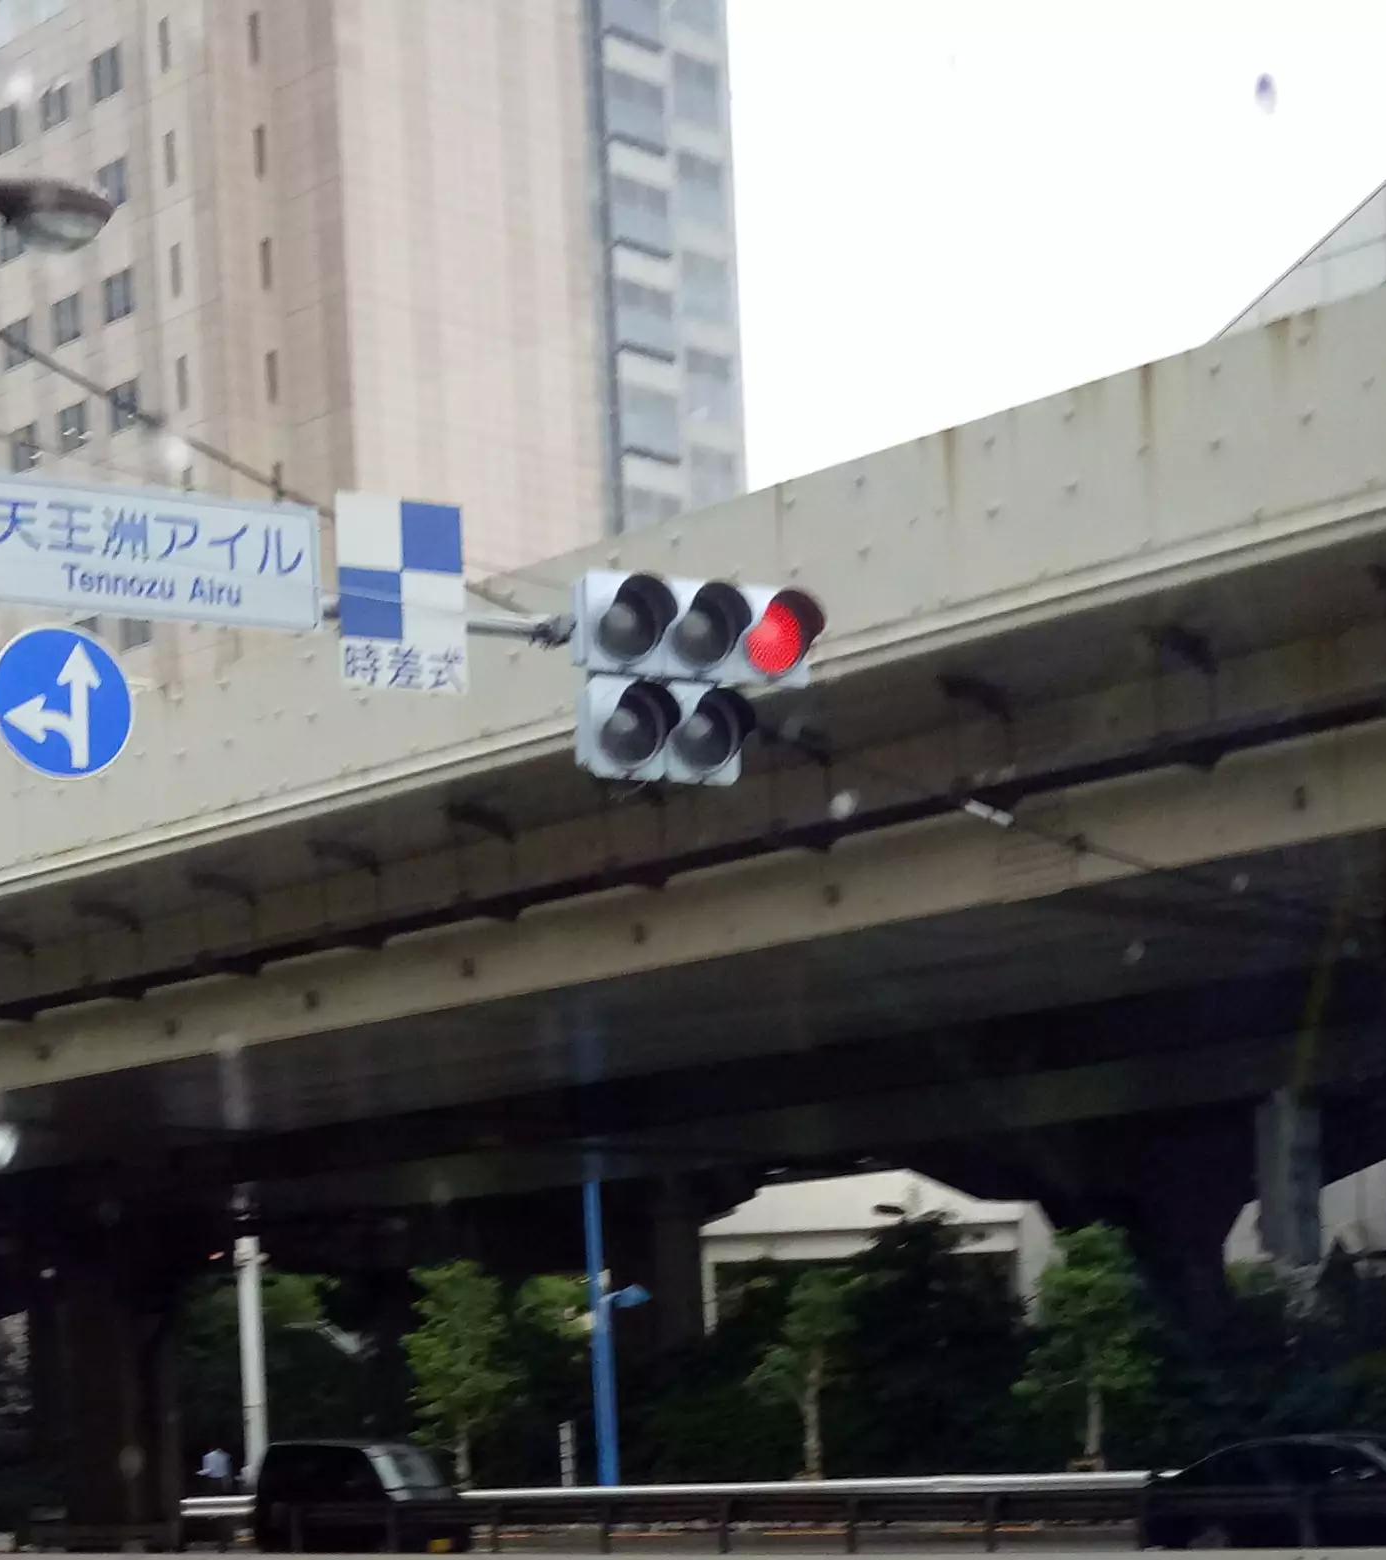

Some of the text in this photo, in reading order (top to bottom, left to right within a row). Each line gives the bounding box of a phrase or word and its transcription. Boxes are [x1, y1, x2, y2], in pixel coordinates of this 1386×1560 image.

[62, 562, 242, 607] Tennozu Airu
[344, 641, 464, 692] 時差式
